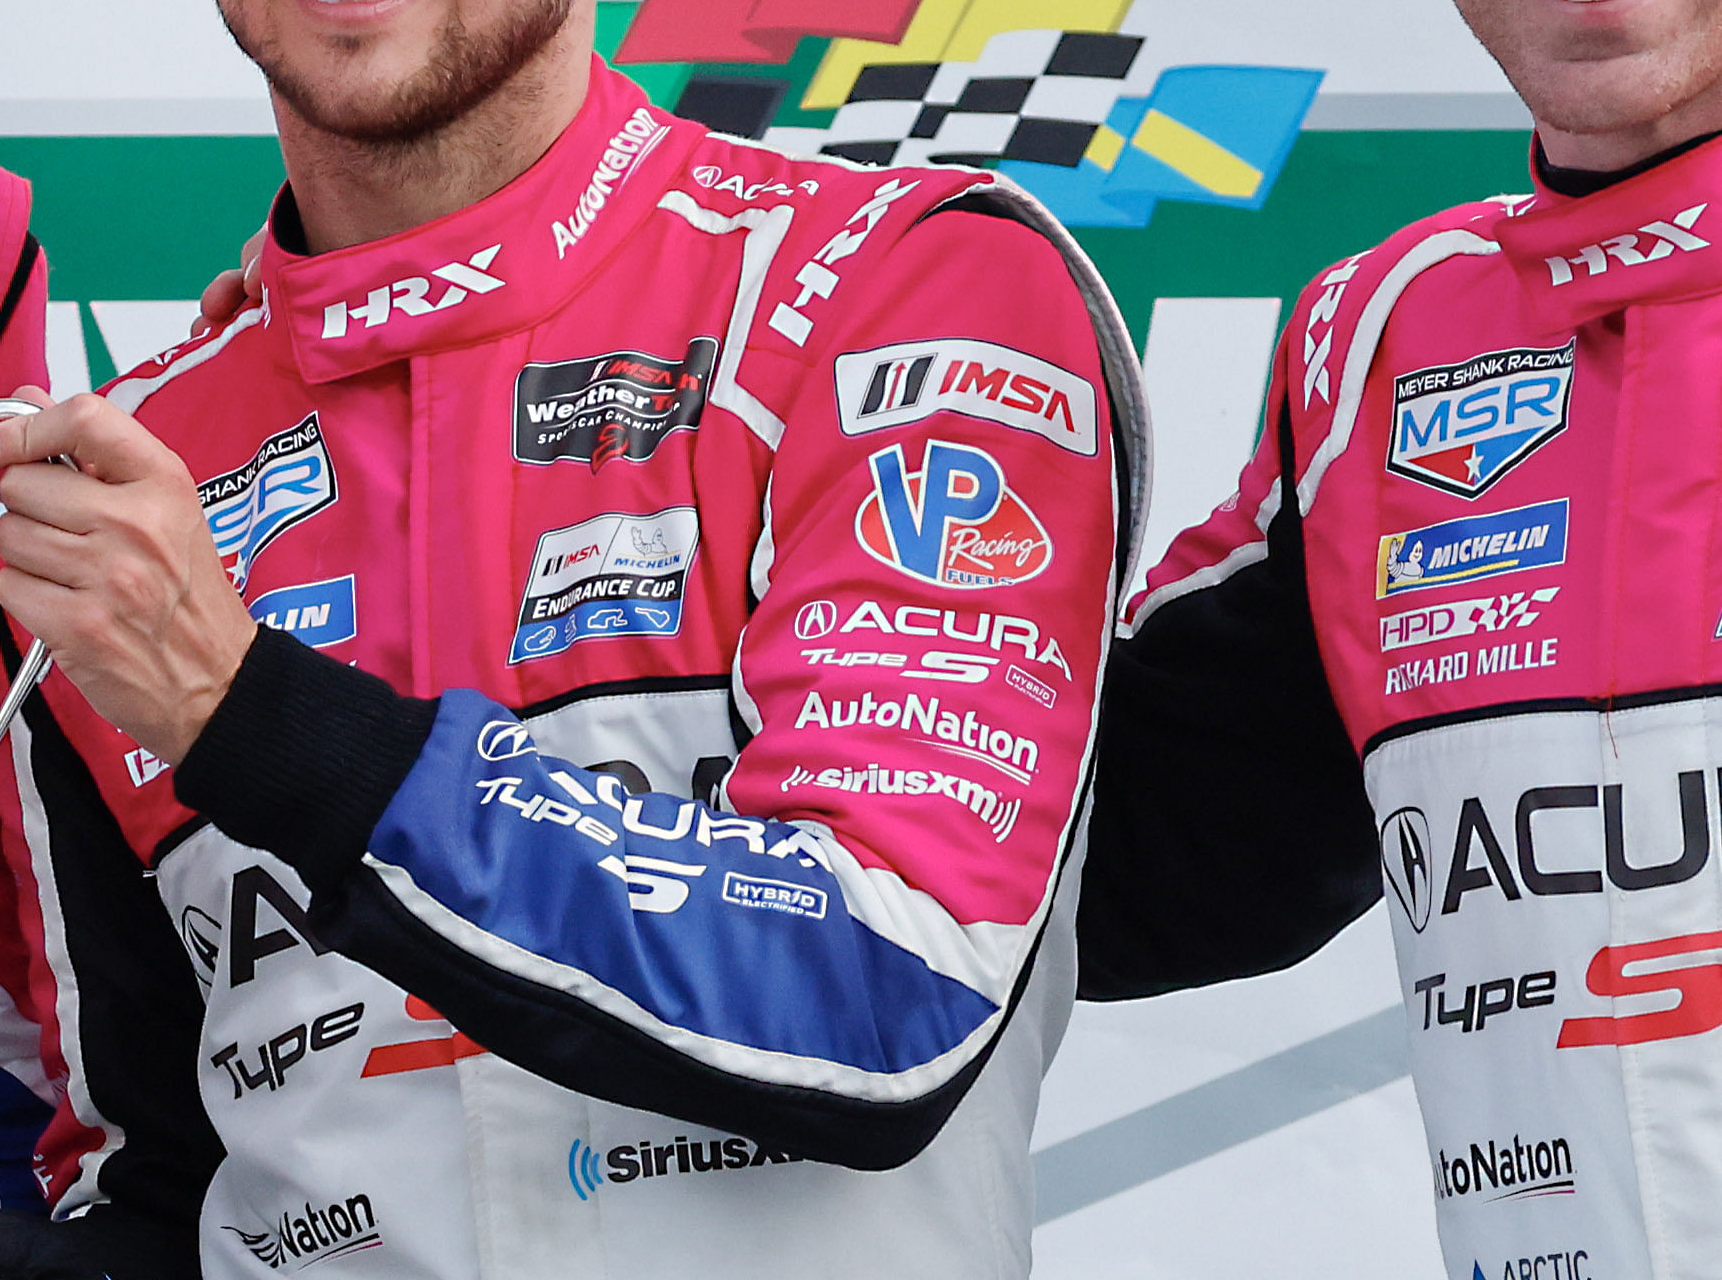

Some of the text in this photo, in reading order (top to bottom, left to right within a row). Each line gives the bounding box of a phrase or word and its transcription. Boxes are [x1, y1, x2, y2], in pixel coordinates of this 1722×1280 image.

[551, 107, 660, 260] AutoNation
[768, 178, 923, 348] HRX
[1544, 203, 1712, 287] HRX
[321, 243, 507, 340] HRX
[609, 360, 673, 385] IMSA
[1398, 348, 1574, 399] MEYER SHANK RACING
[938, 360, 1077, 434] IMSA
[1399, 376, 1561, 452] MSR
[257, 423, 318, 469] RACING
[209, 455, 322, 549] SR
[869, 439, 1006, 582] VP
[563, 544, 682, 569] IMSA MICHELIN
[948, 528, 1047, 570] Racing
[1427, 524, 1550, 570] MICHELIN
[533, 579, 677, 619] ENDURANCE CUP
[840, 601, 1073, 682] ACURA
[1382, 608, 1456, 647] HPD
[899, 651, 1000, 683] S
[1476, 638, 1558, 677] MILLE
[1011, 670, 1051, 702] HYBRID
[795, 691, 1040, 773] AutoNation
[734, 881, 816, 907] HYBRID
[740, 899, 805, 915] ELECTRIFIED
